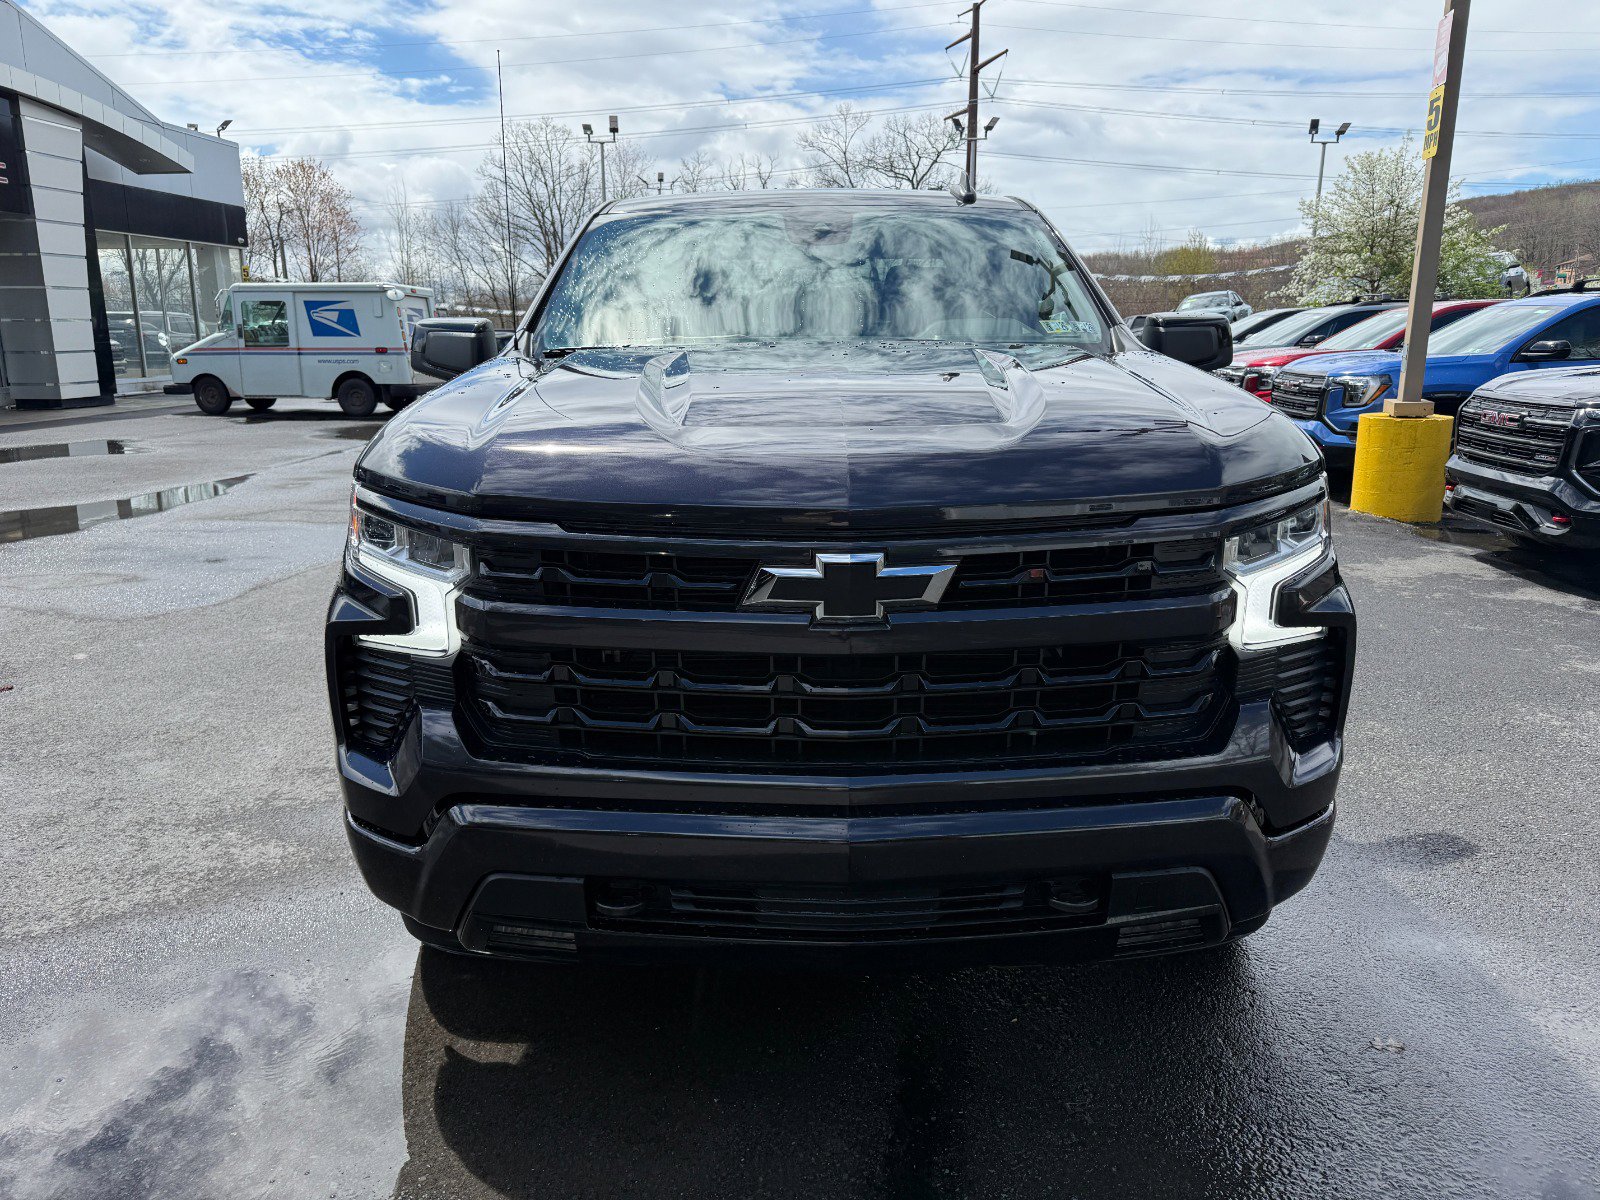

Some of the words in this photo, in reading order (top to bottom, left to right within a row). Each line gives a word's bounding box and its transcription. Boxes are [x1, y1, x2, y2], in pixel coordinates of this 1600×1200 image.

[1427, 95, 1442, 132] 5
[1424, 130, 1439, 152] MPH
[1480, 409, 1521, 427] GMC
